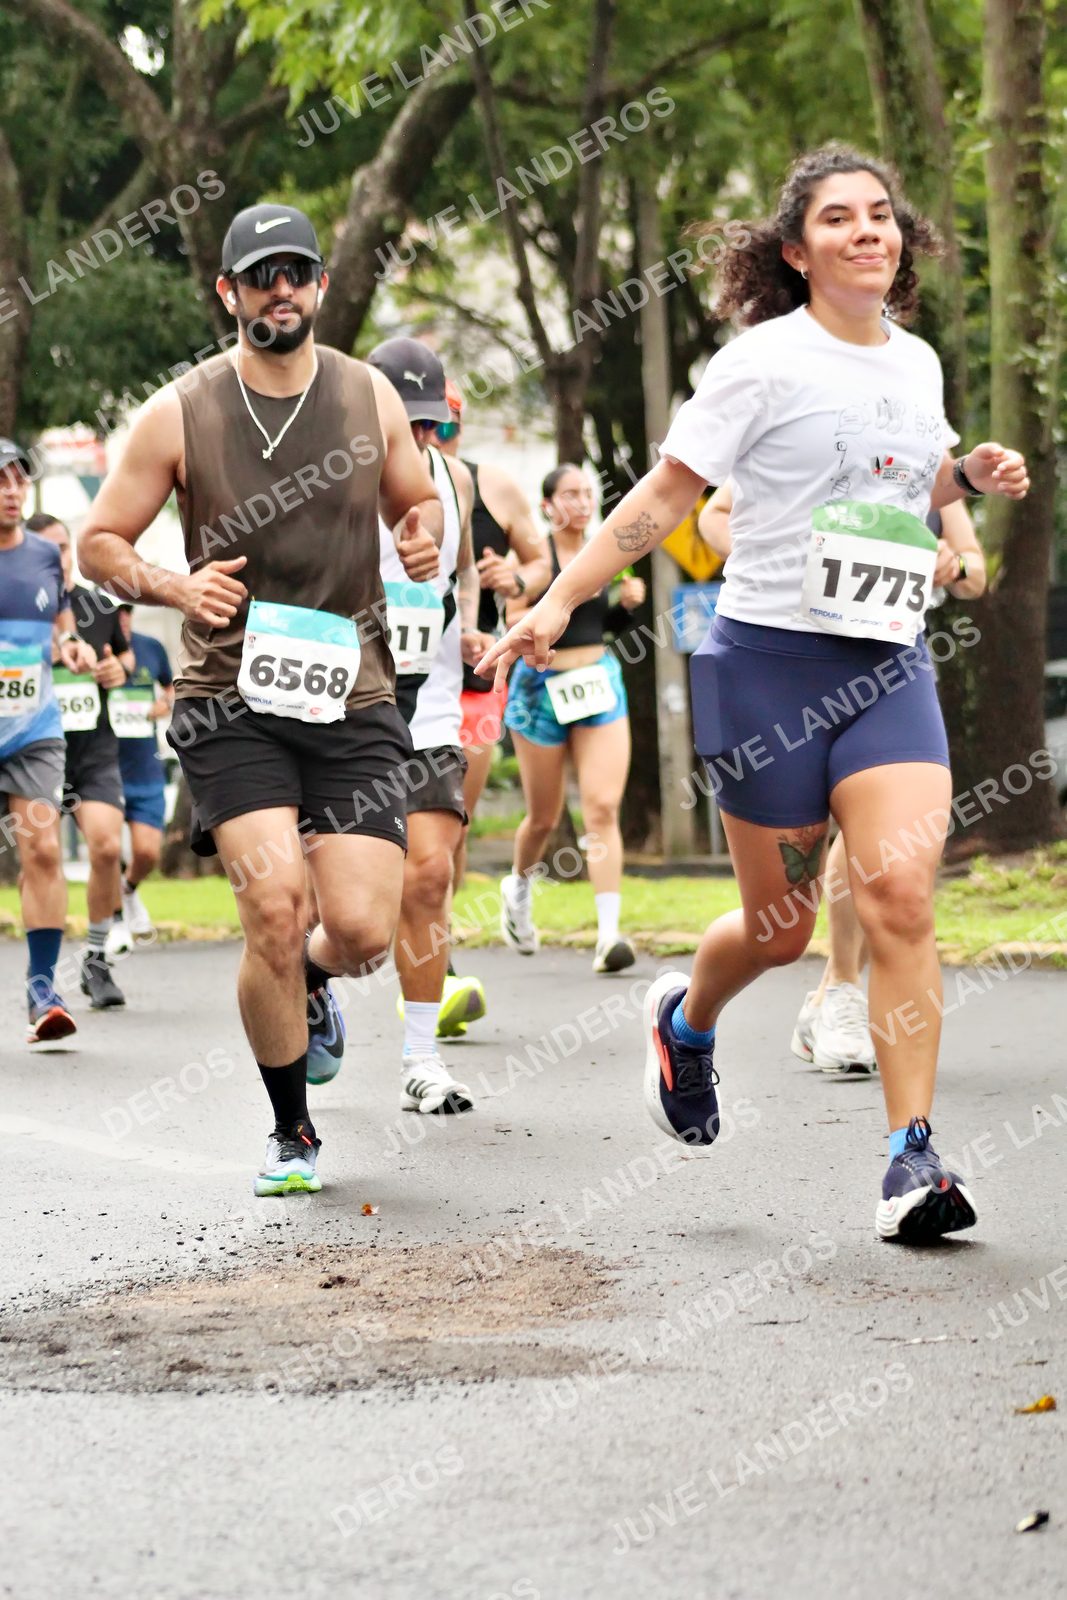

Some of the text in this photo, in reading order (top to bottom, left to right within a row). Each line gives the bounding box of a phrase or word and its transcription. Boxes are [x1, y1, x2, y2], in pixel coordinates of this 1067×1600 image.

[821, 557, 927, 613] 1773
[384, 624, 430, 653] 11
[249, 654, 349, 700] 6568
